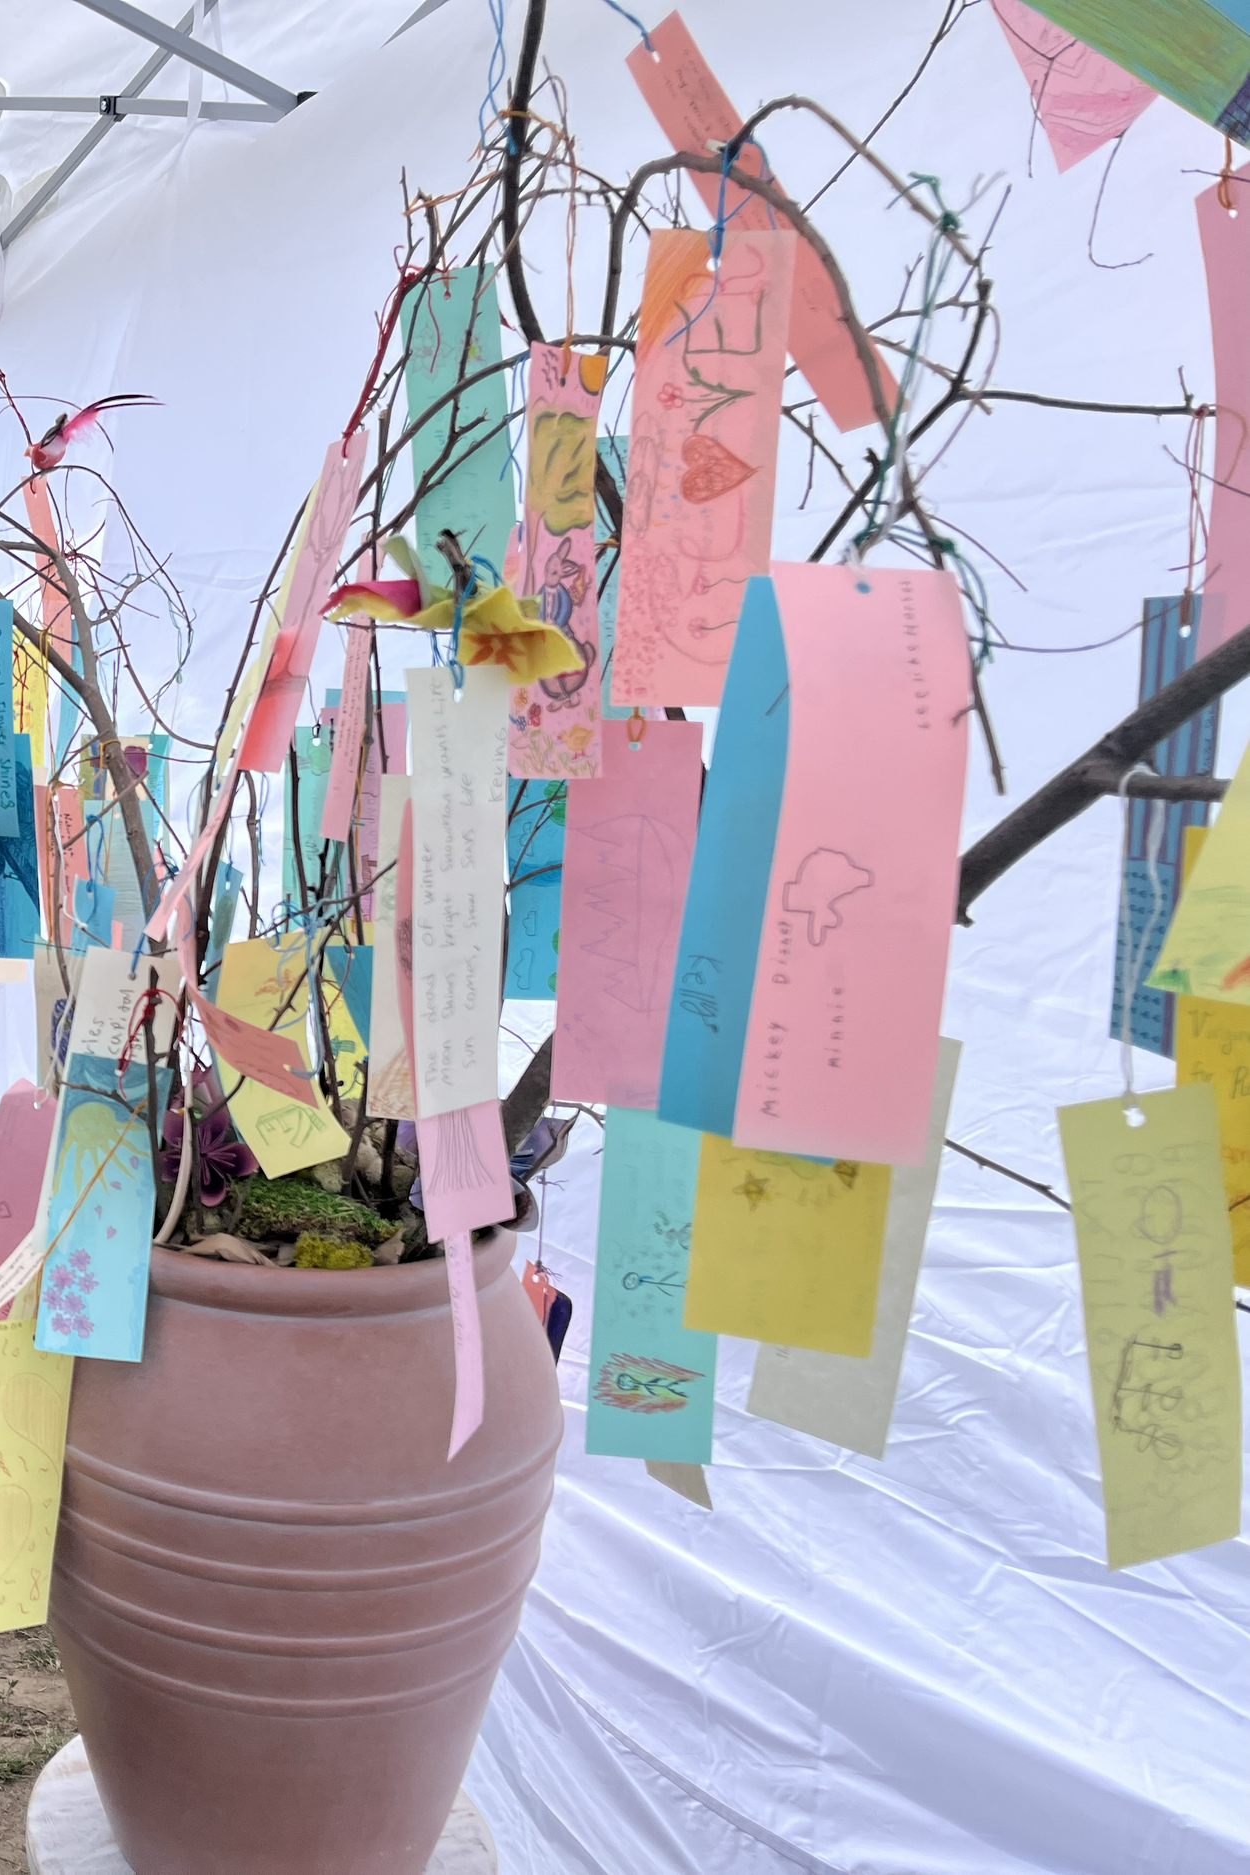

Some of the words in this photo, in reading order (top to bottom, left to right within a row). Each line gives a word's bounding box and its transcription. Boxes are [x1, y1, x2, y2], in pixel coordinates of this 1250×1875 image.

[419, 842, 435, 906] winter
[439, 893, 460, 949] bright
[418, 972, 437, 1023] dead
[678, 954, 723, 1035] Kelly
[80, 1016, 105, 1056] rles
[823, 985, 845, 1070] Minnie
[423, 1050, 438, 1088] The
[755, 1021, 789, 1119] Mickey
